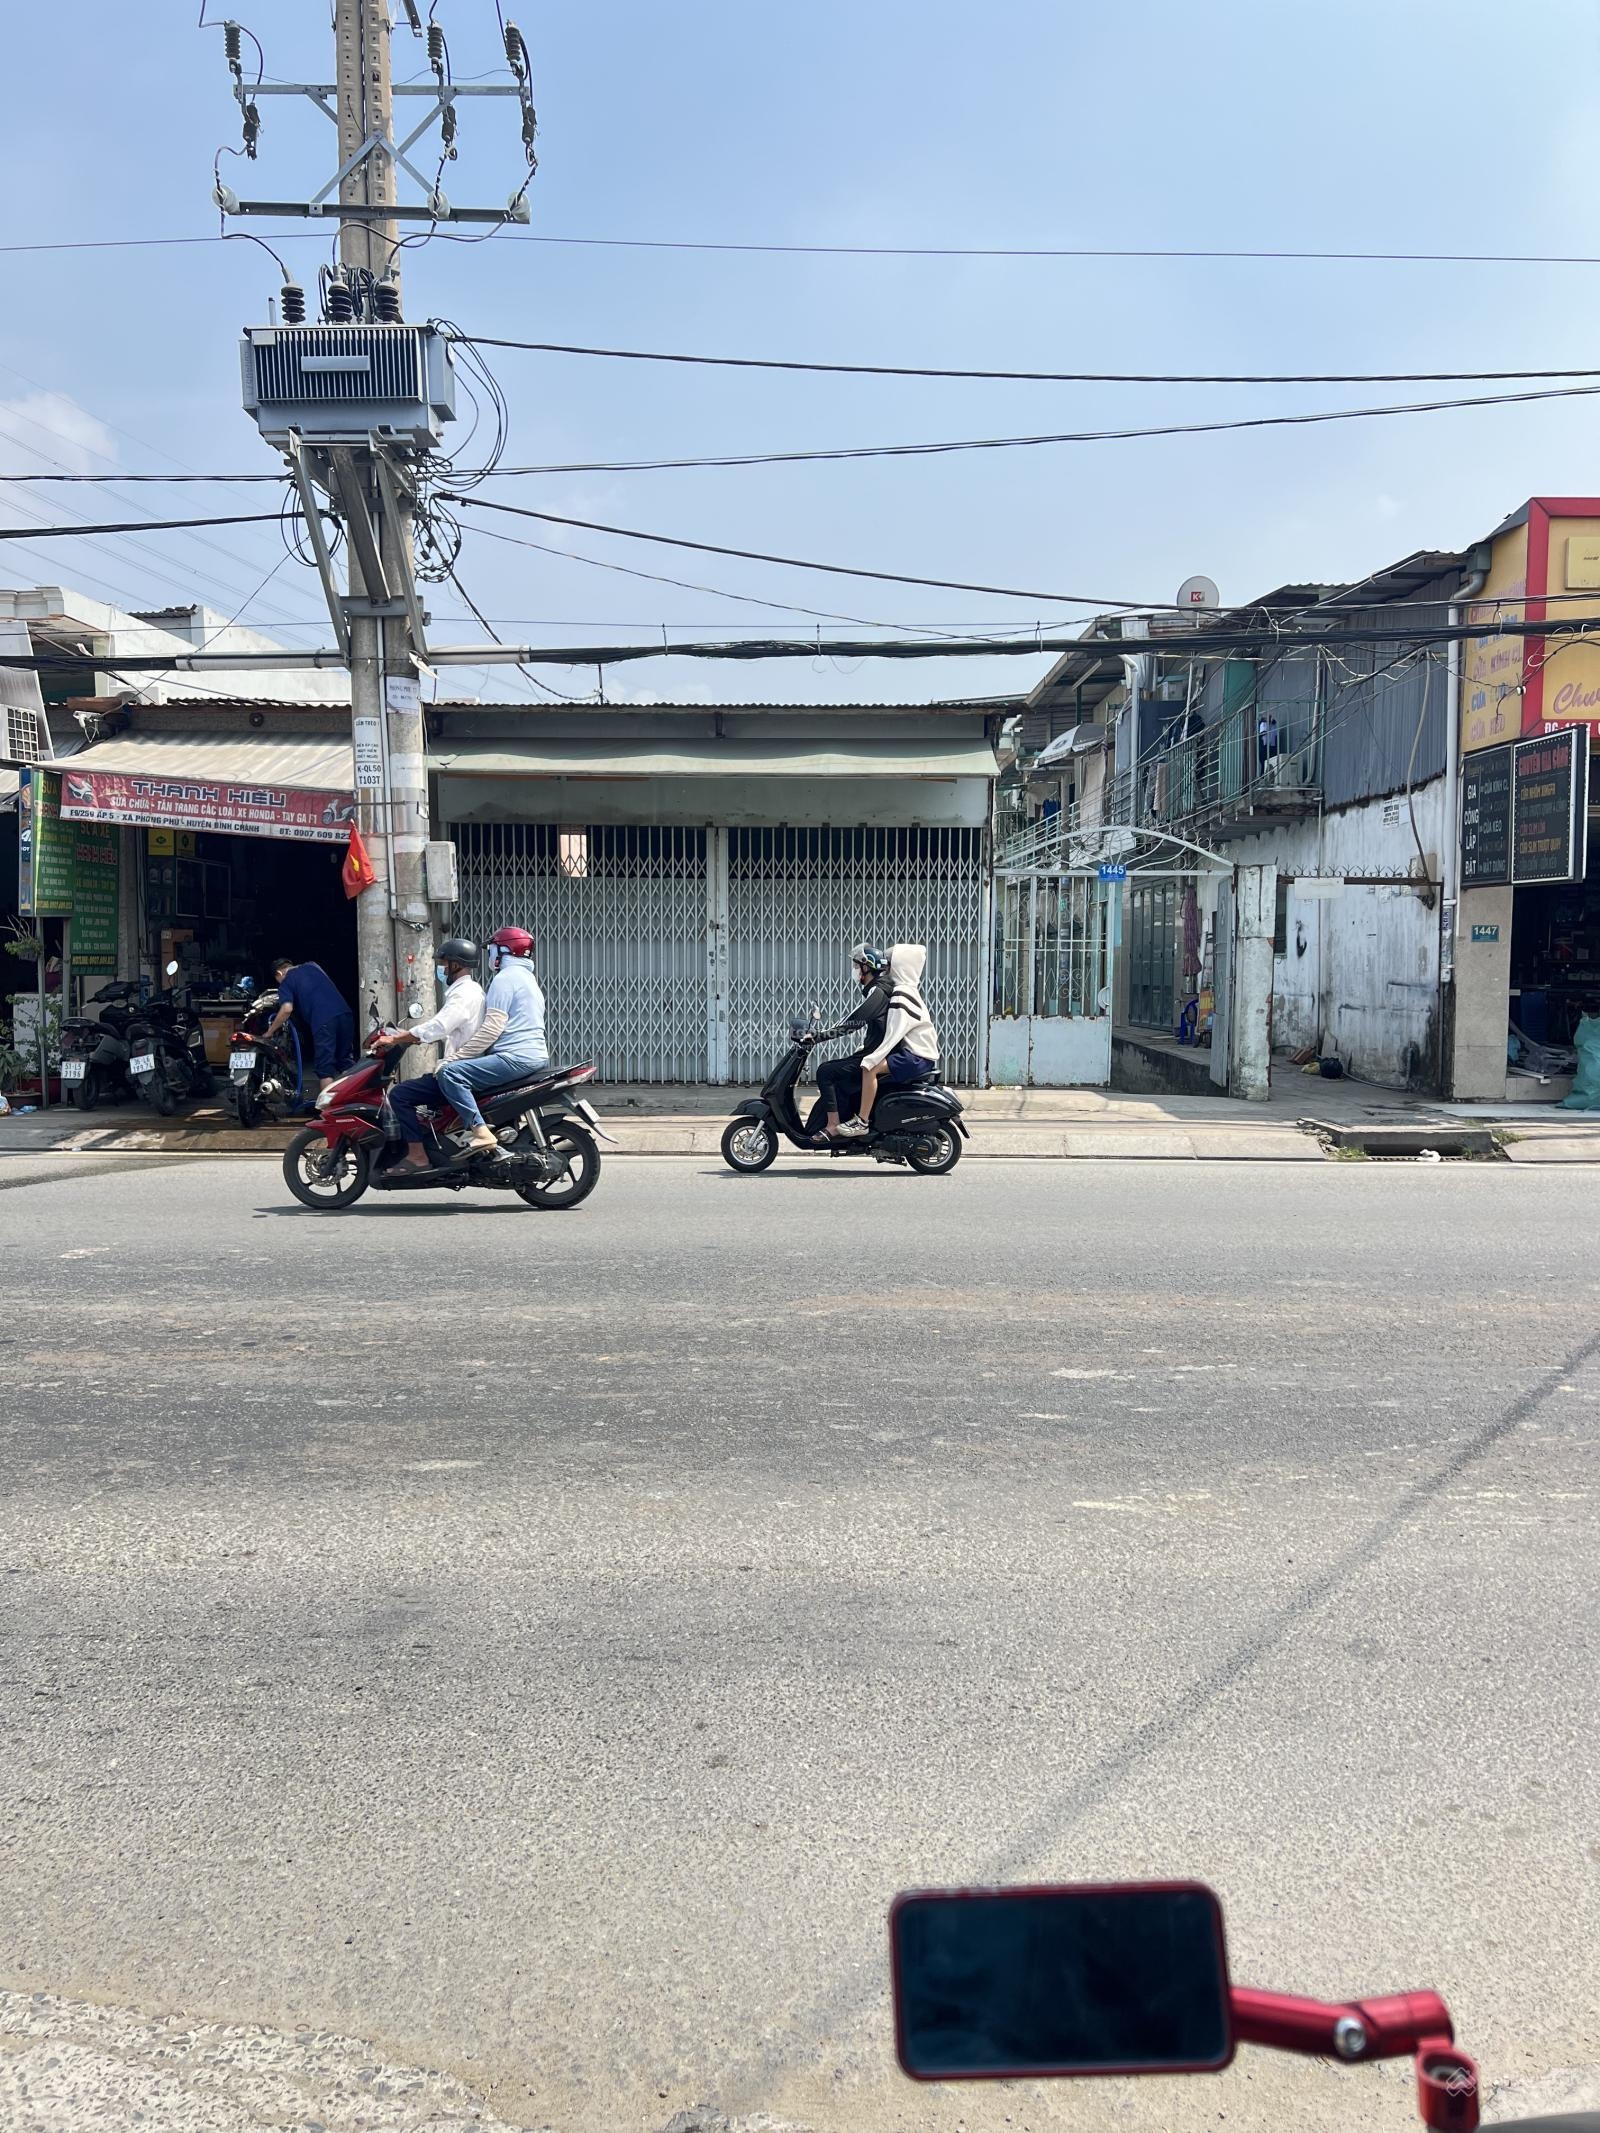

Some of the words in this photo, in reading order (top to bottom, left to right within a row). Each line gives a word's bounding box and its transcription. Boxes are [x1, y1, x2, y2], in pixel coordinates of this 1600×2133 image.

[359, 776, 380, 784] T103T
[132, 780, 219, 802] THANH
[1467, 784, 1476, 799] GIA
[238, 807, 247, 818] XE
[249, 809, 275, 820] HONDA
[1102, 866, 1124, 874] 1445
[1474, 927, 1497, 935] 1447
